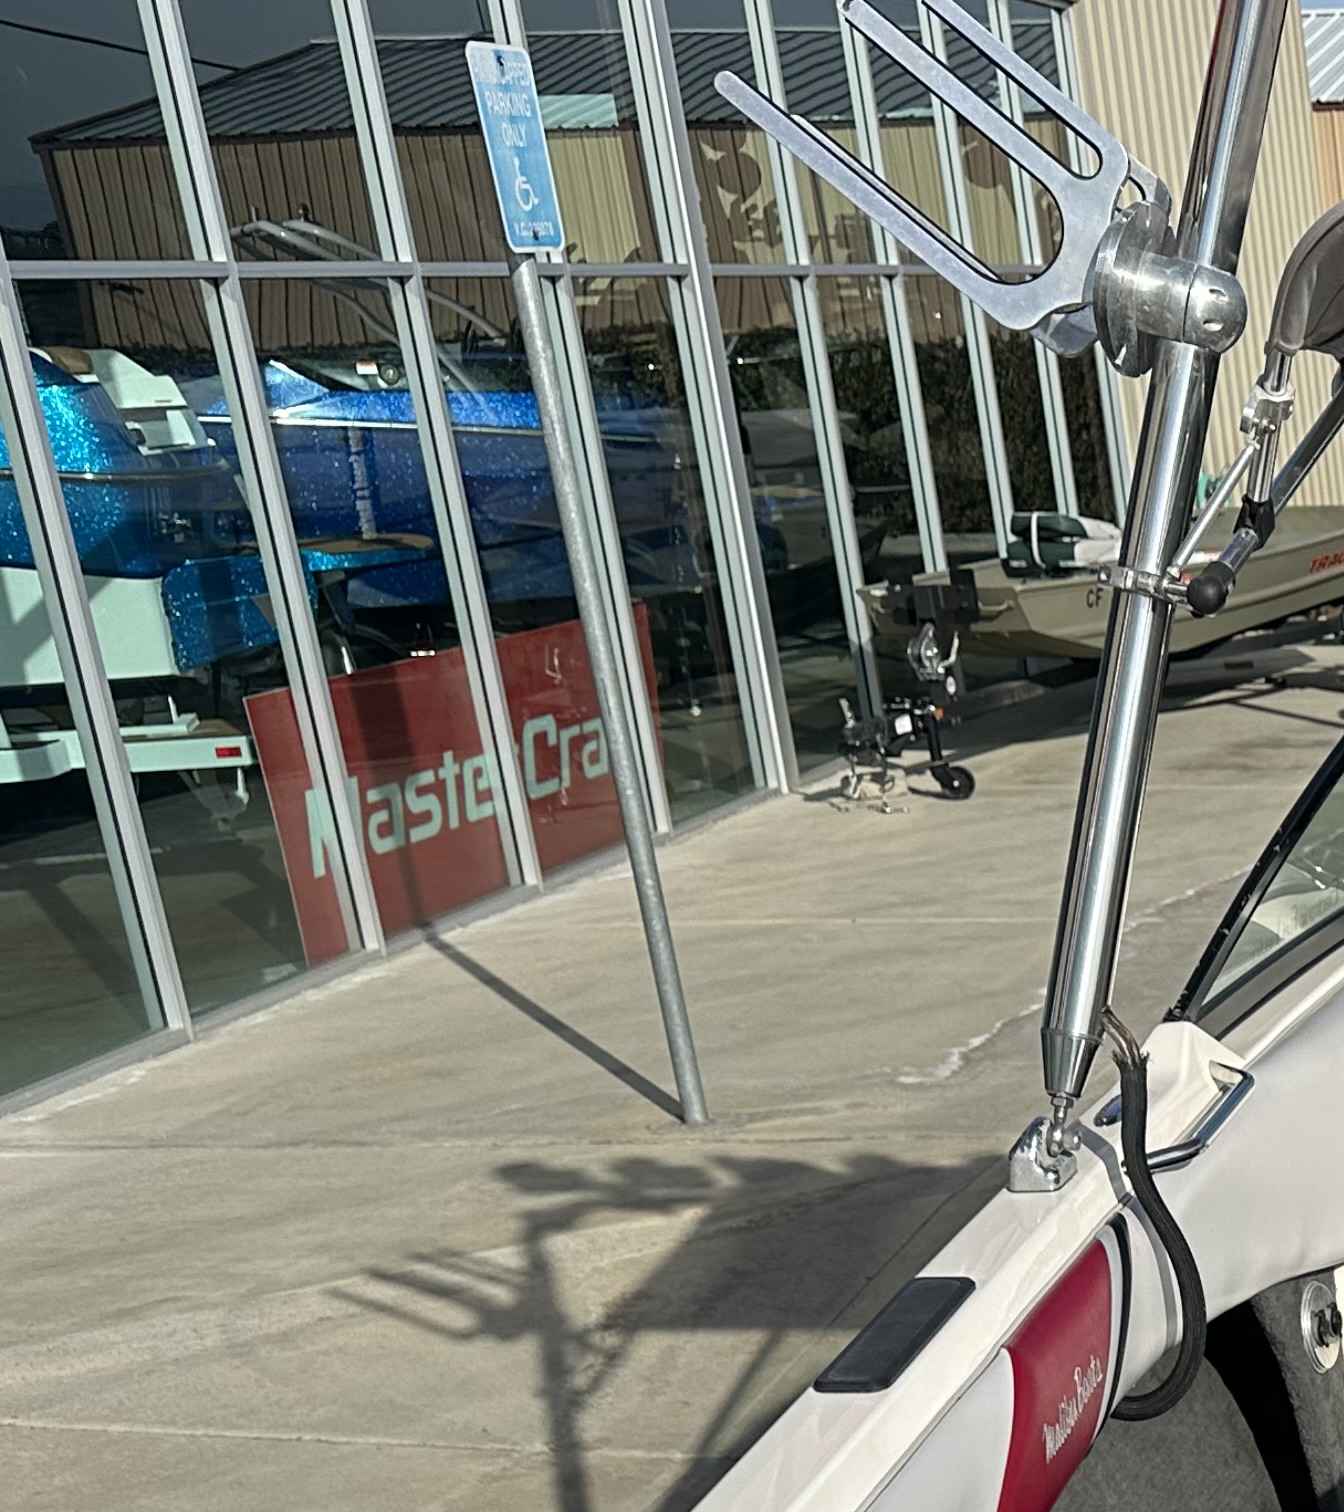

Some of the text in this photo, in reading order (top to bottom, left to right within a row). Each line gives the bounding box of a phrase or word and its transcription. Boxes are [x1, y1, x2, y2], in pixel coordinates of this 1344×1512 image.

[485, 91, 532, 117] PARKING
[500, 122, 528, 147] ONLY
[304, 714, 611, 879] MasteCra
[1042, 1353, 1103, 1465] Malibu Boats
